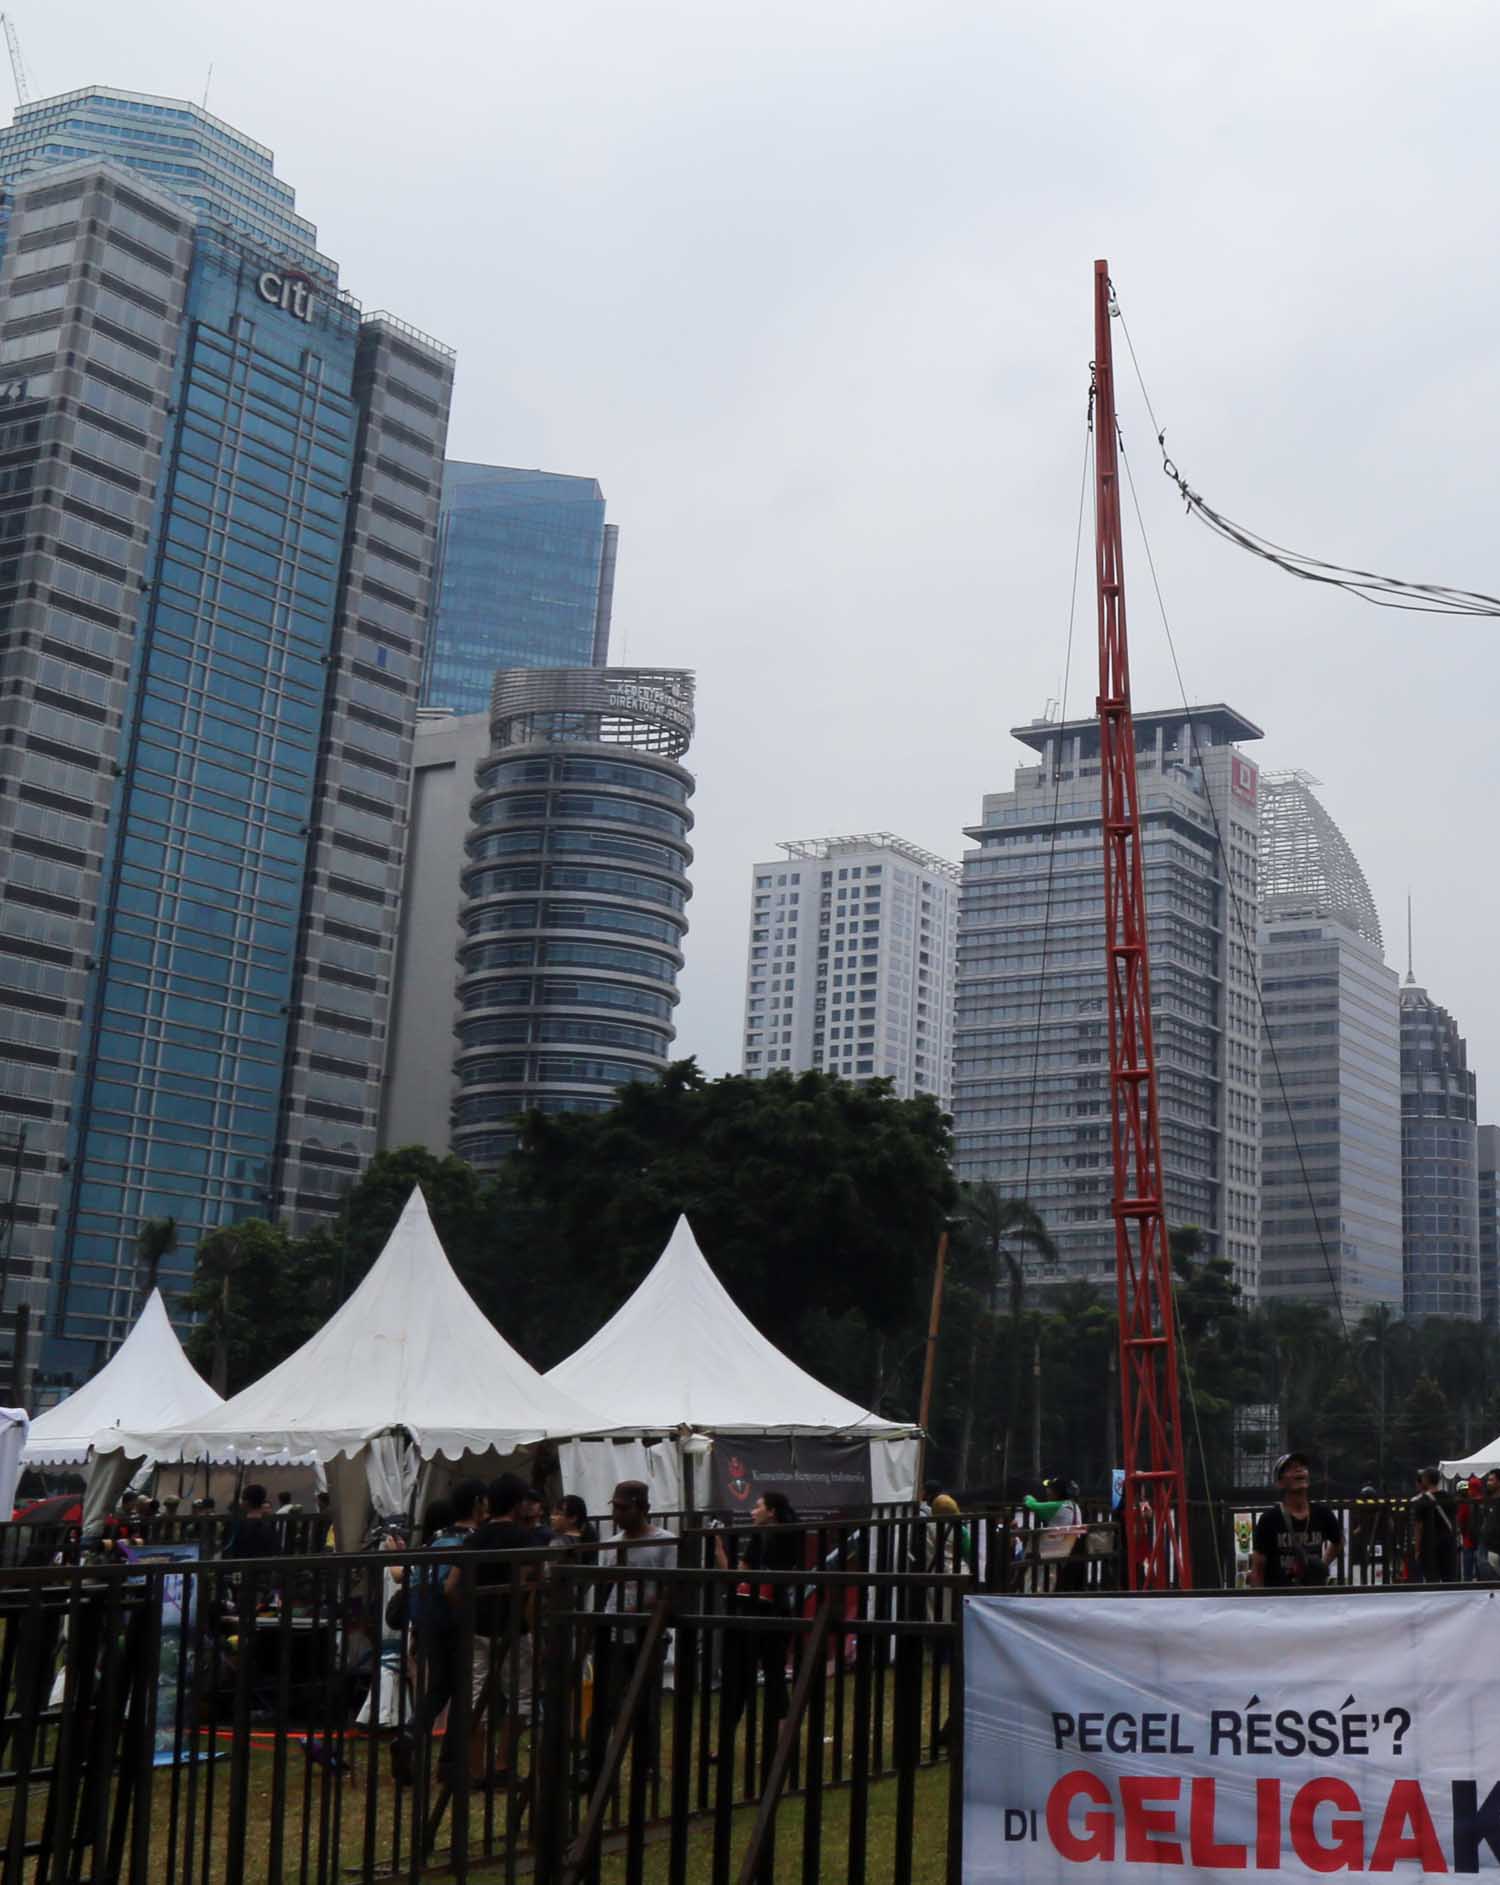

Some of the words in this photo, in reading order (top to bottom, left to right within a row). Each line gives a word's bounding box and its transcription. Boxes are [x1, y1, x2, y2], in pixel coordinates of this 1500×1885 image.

[260, 272, 313, 322] citi
[1051, 1711, 1194, 1754] PEGEL
[1004, 1808, 1038, 1842] DI
